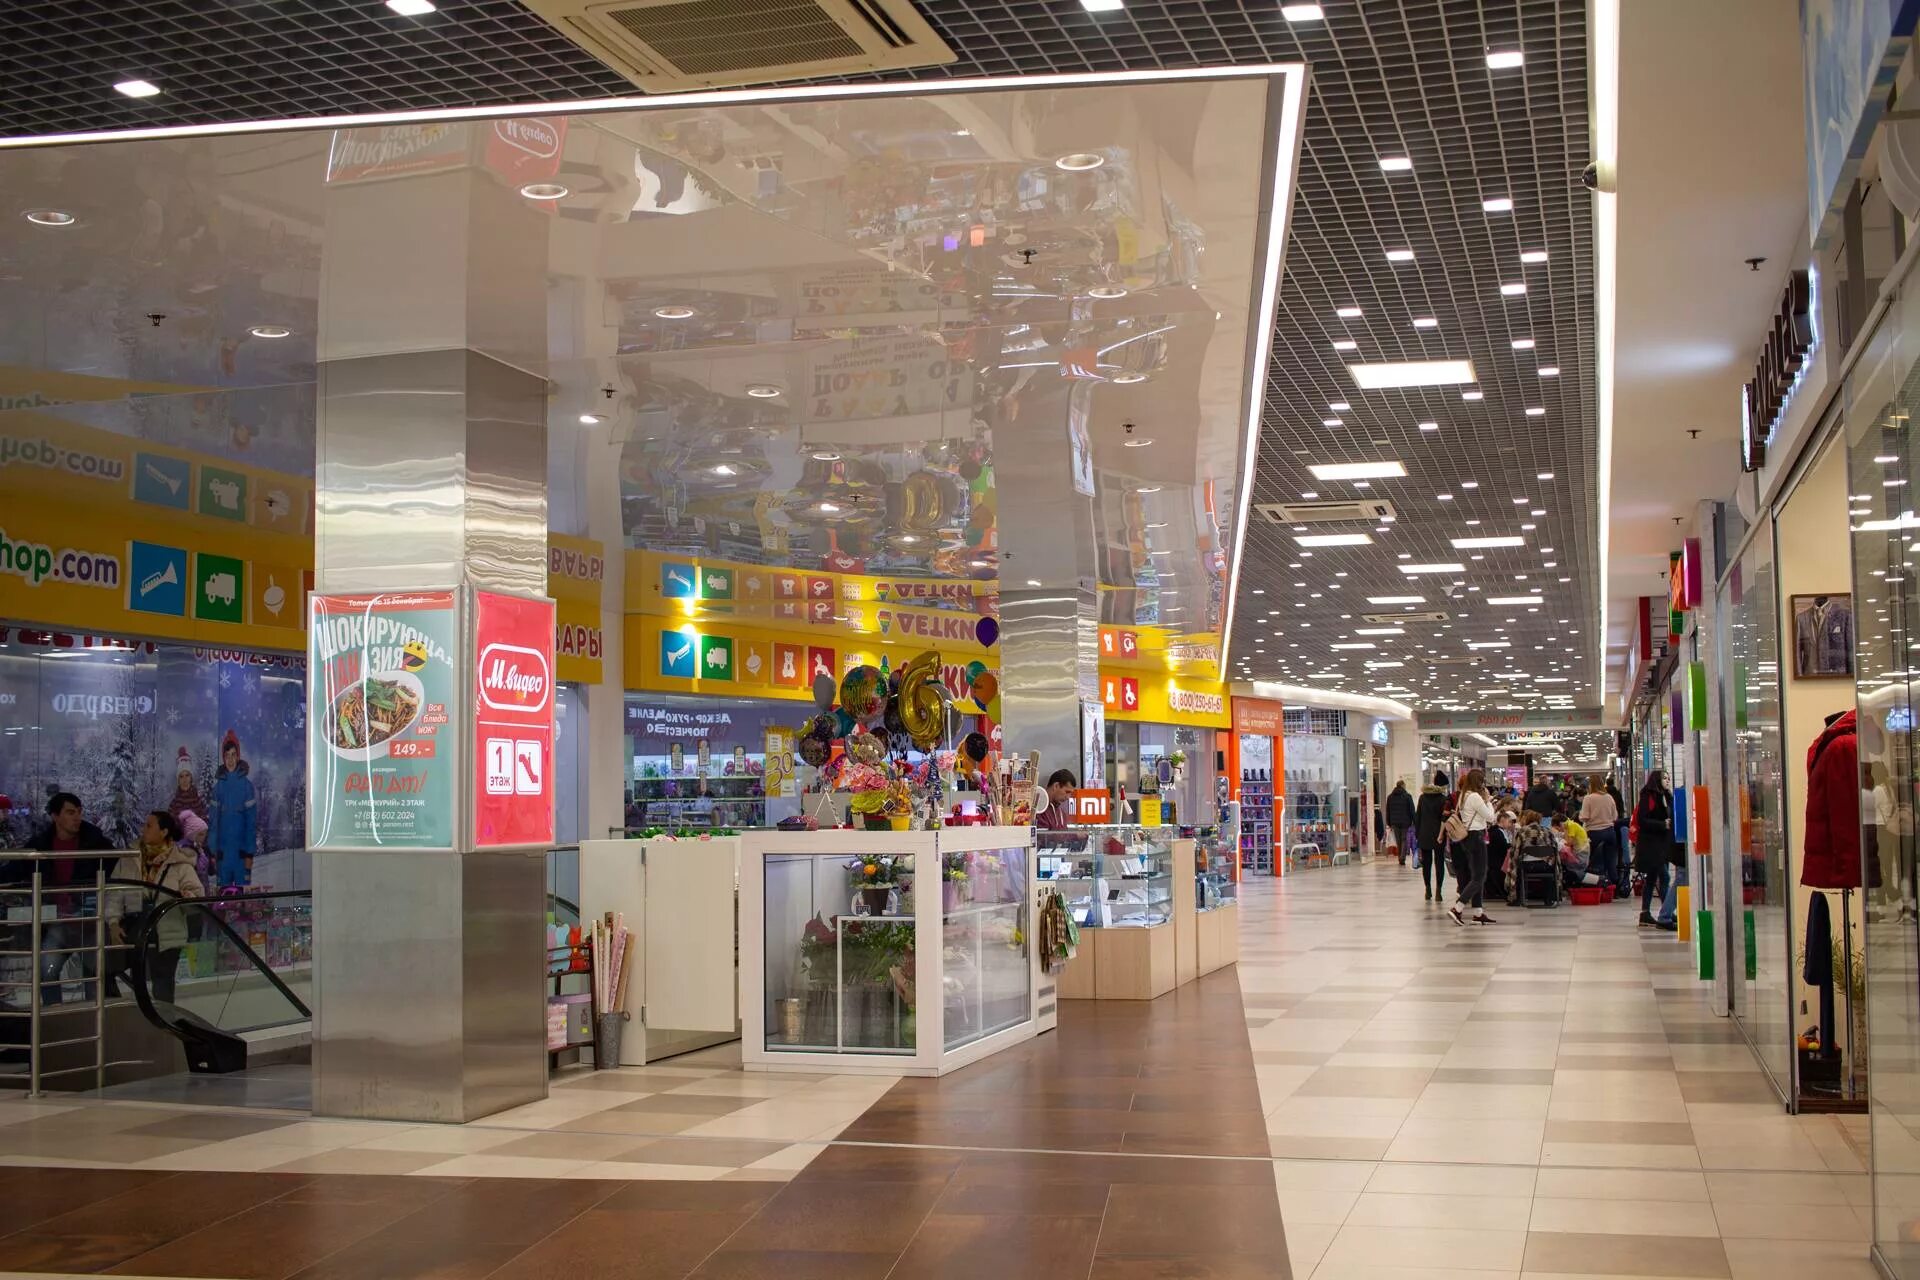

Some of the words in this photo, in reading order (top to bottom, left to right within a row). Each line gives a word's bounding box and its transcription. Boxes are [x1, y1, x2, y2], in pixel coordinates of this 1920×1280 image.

[486, 658, 543, 699] М.видео
[495, 746, 502, 774] 1
[489, 776, 511, 787] этаж
